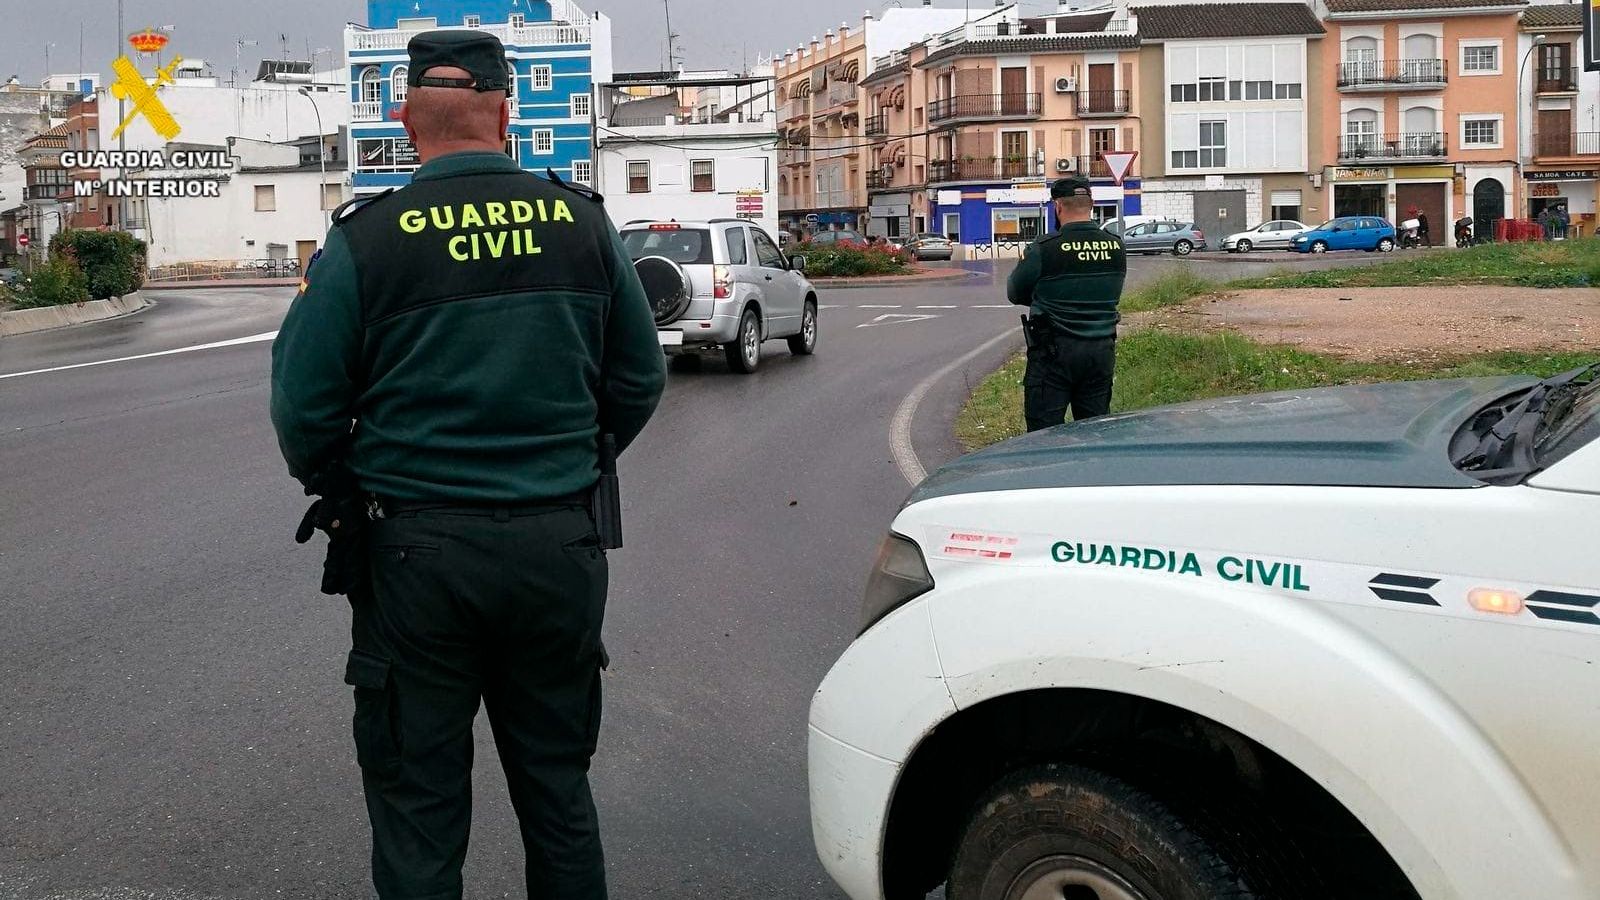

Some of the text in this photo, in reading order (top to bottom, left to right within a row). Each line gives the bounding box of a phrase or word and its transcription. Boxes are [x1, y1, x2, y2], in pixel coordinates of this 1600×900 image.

[399, 199, 575, 234] GUARDIA
[448, 229, 542, 262] CIVIL
[1061, 240, 1121, 251] GUARDIA
[1077, 251, 1111, 261] CIVIL
[1051, 541, 1310, 592] GUARDIA CIVIL
